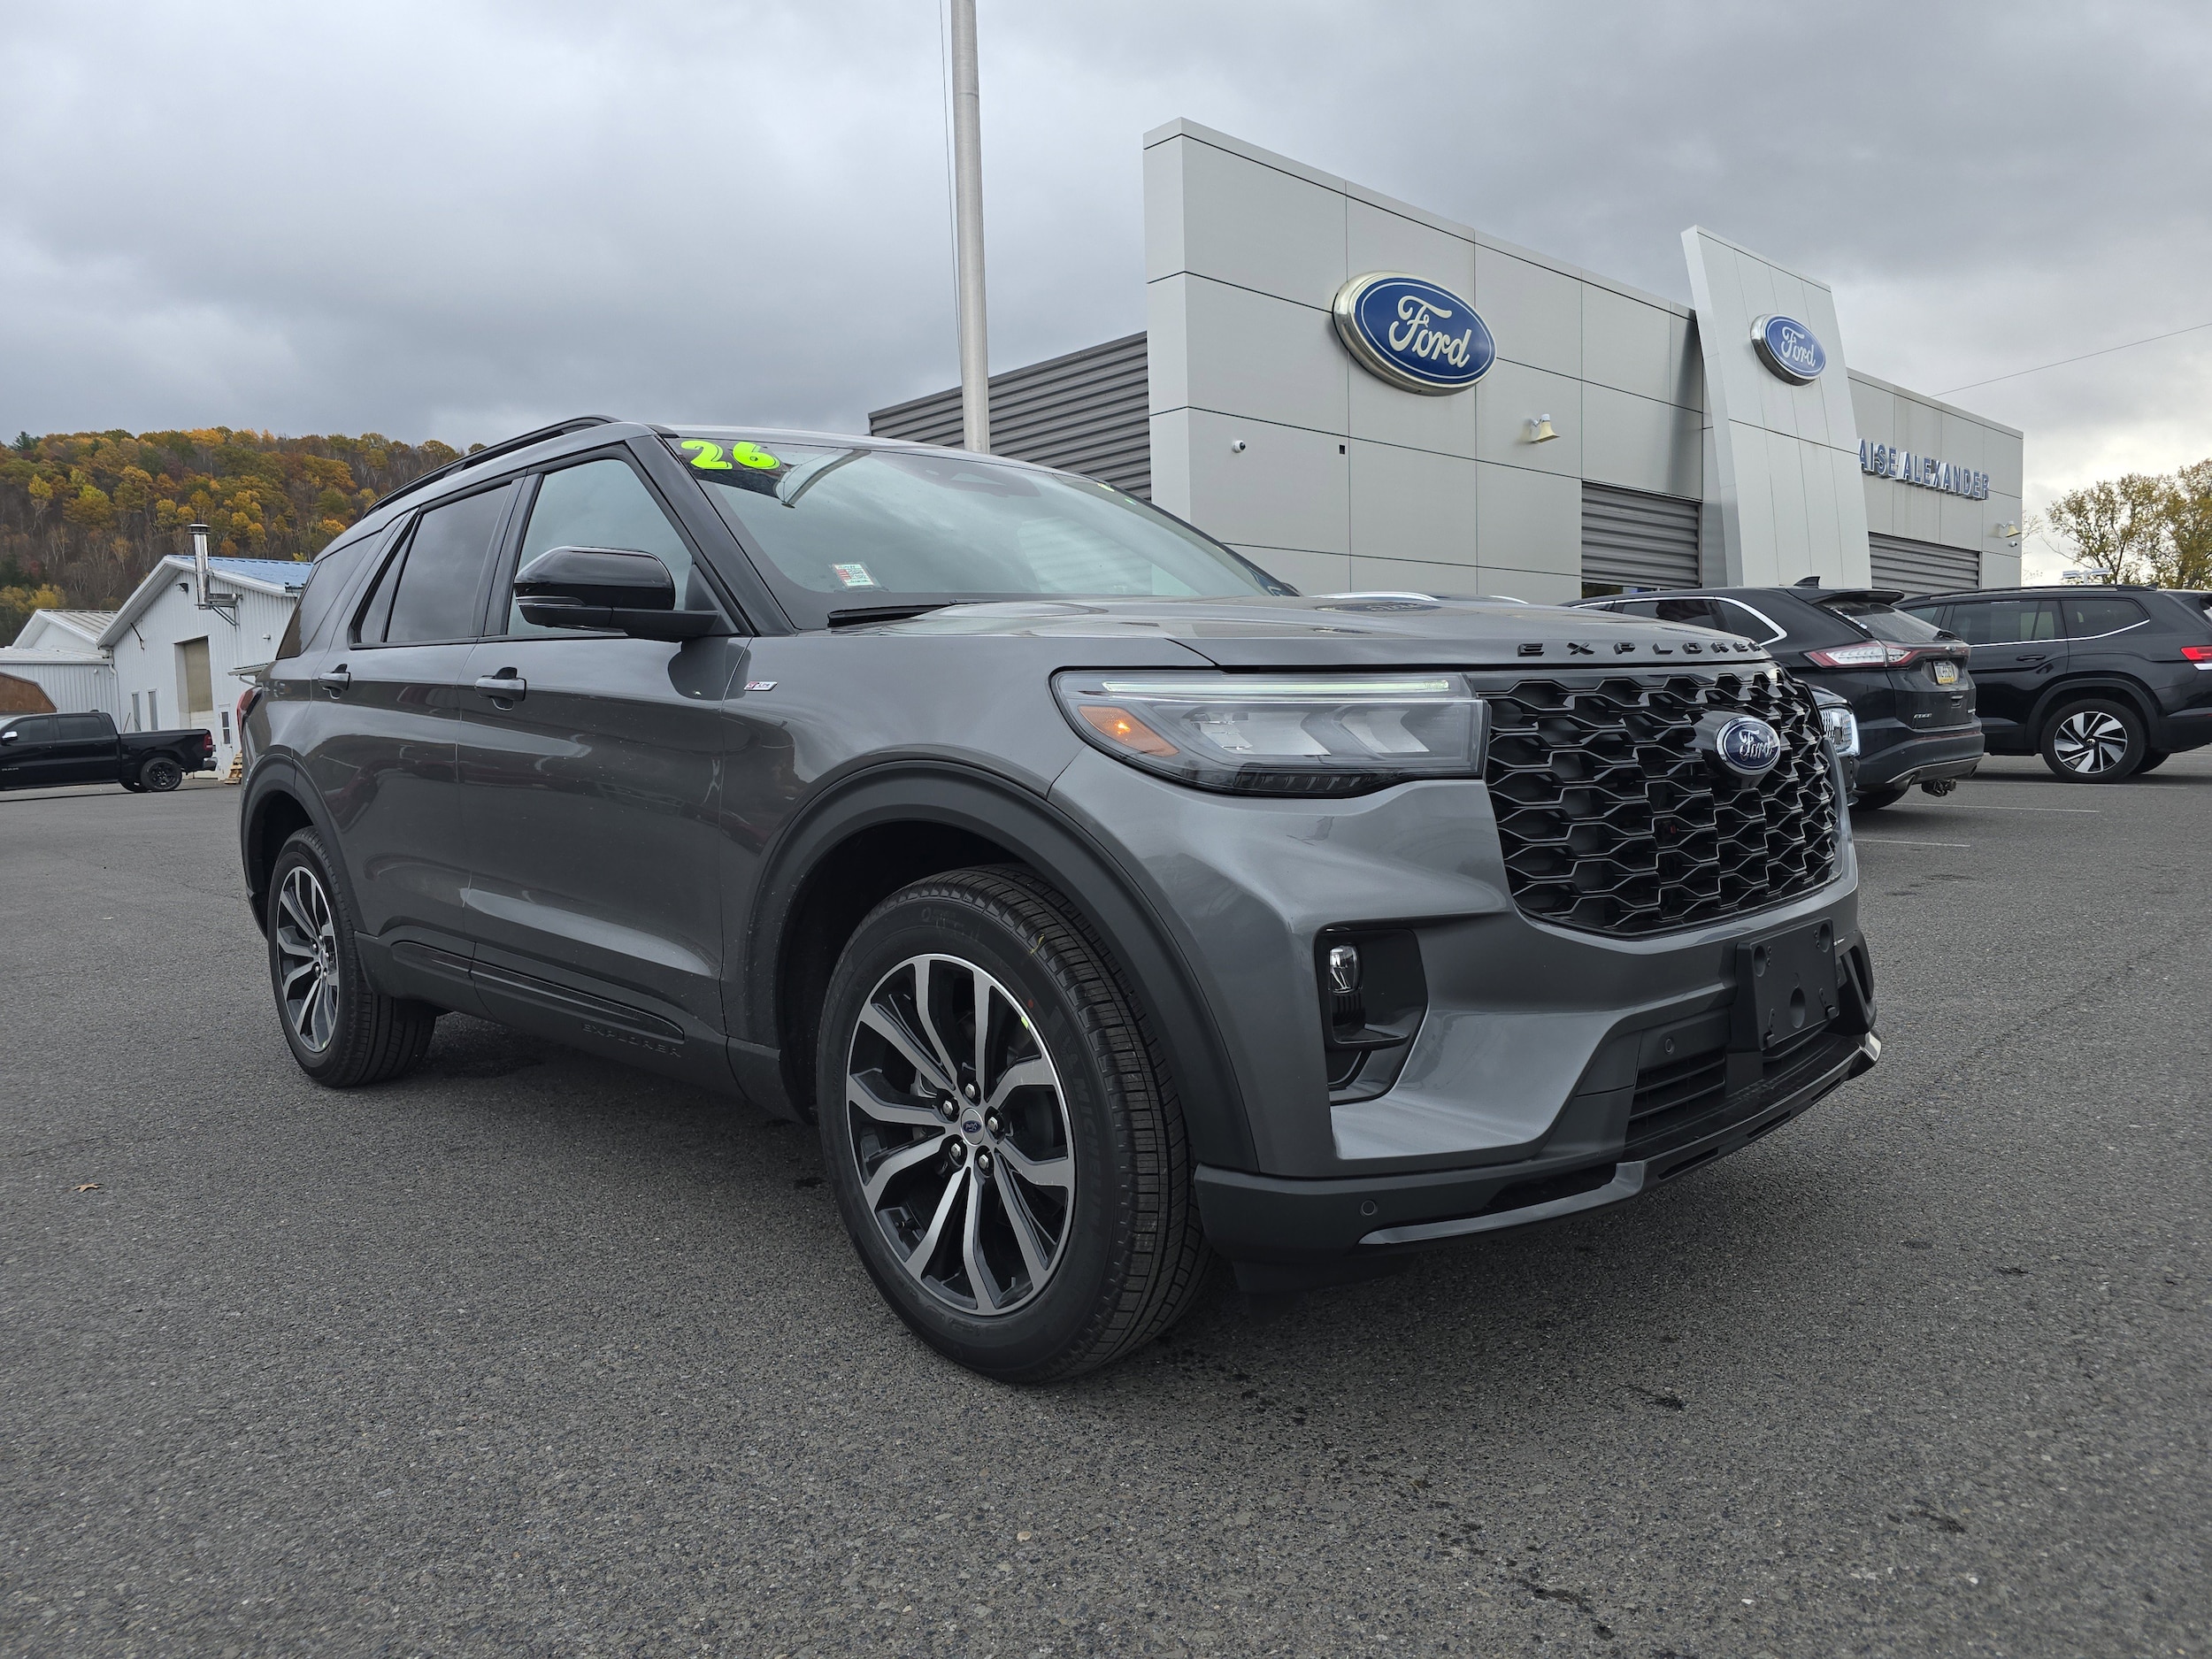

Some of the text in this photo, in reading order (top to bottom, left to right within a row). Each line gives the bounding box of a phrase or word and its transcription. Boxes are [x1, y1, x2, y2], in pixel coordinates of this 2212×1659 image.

[1388, 295, 1472, 368] Ford
[1781, 326, 1816, 367] Ford
[680, 440, 781, 470] 26
[1897, 450, 1990, 501] ALEXANDER
[1738, 728, 1774, 758] Ford
[582, 1023, 681, 1058] EXPLORER
[1071, 1078, 1104, 1233] MICHELIN
